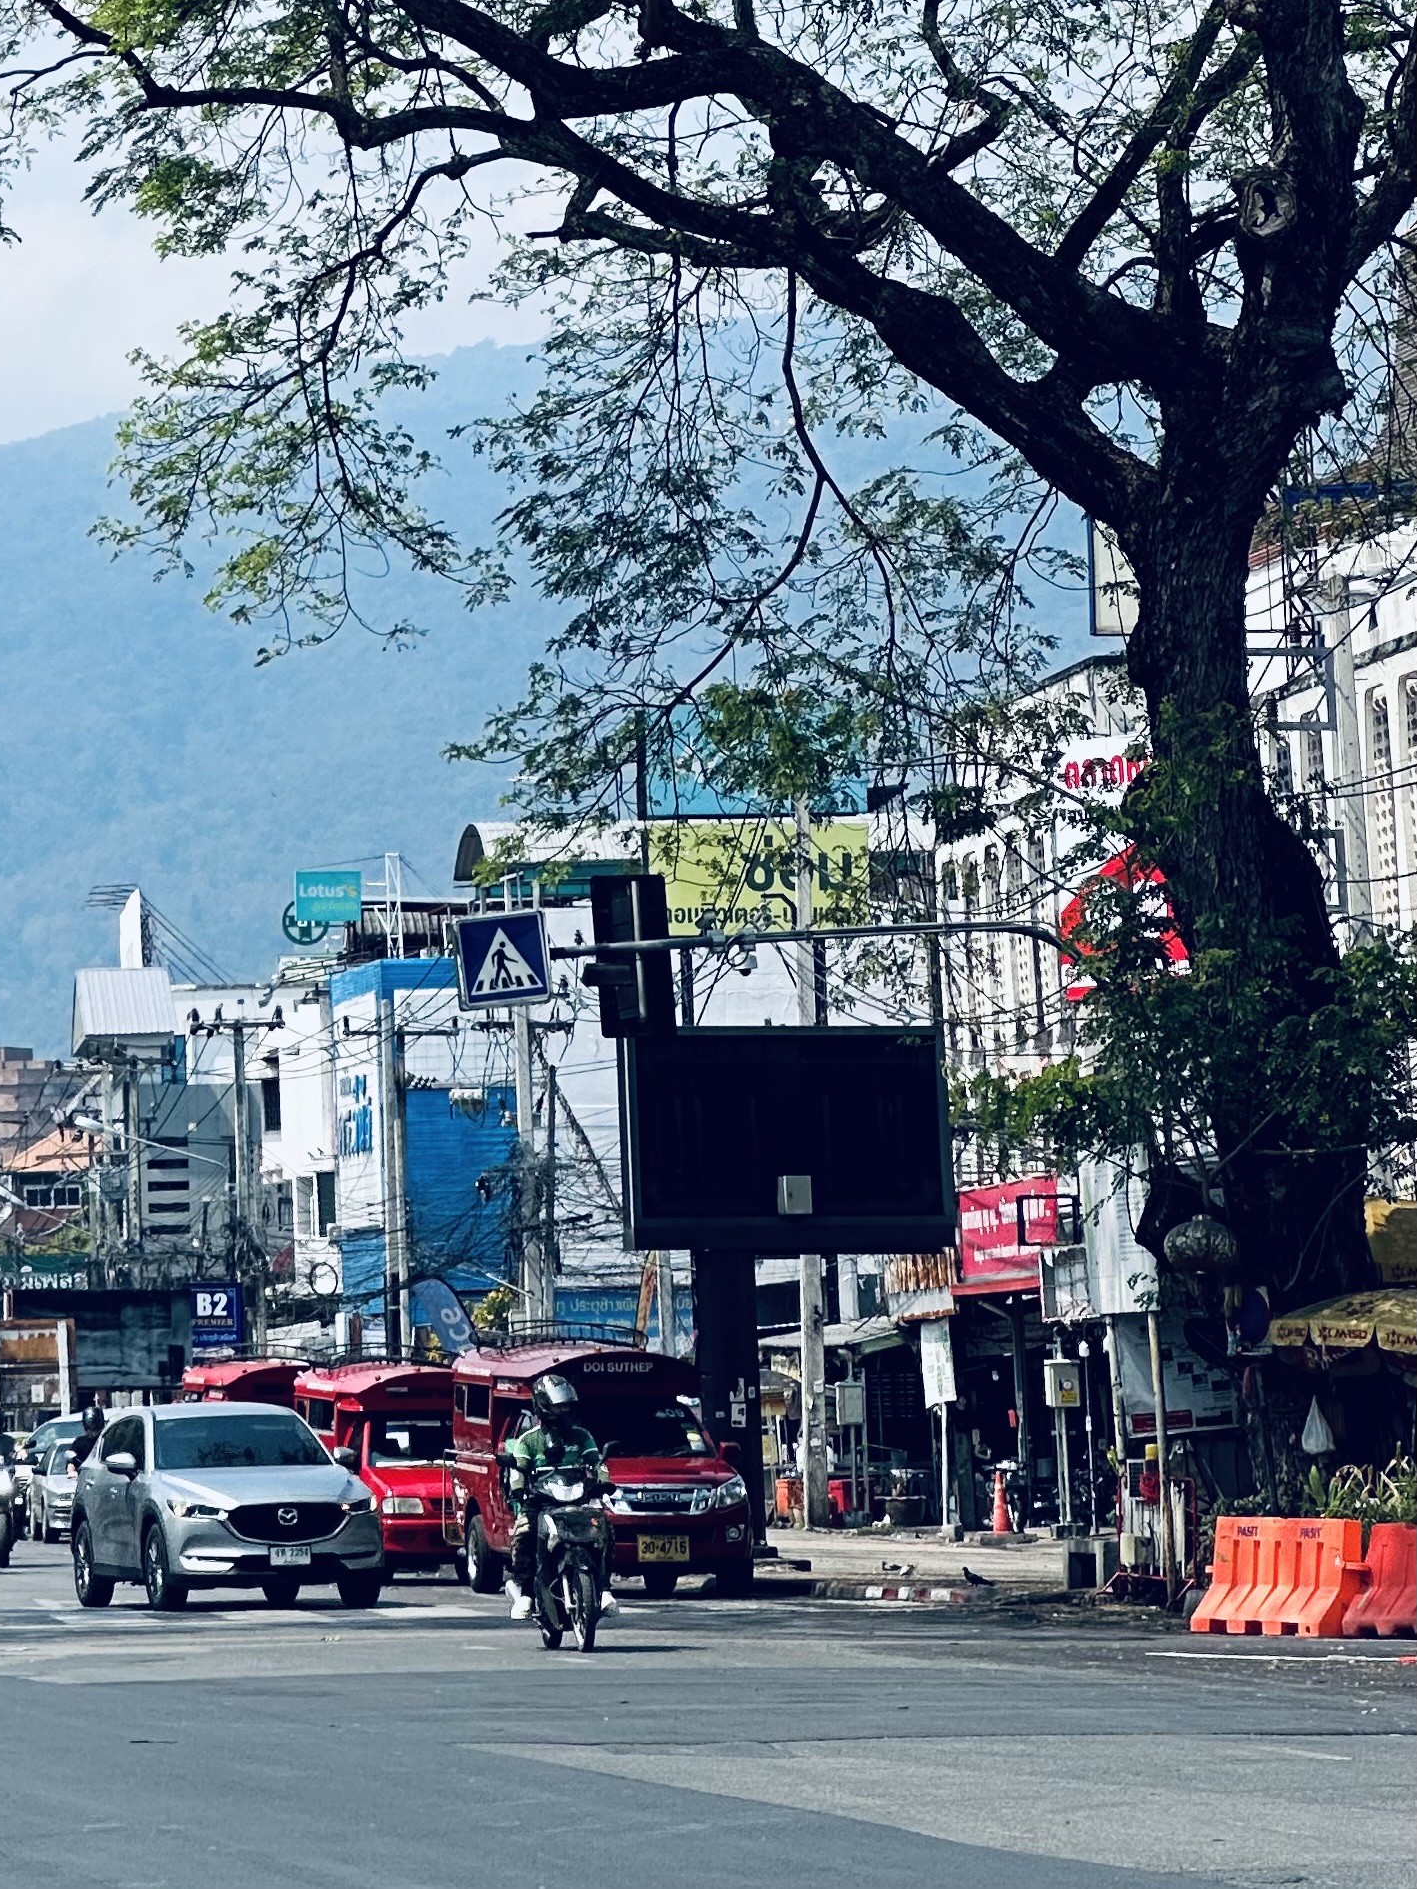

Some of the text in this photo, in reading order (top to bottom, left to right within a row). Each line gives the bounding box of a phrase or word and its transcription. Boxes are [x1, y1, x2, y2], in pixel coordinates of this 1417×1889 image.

[196, 1292, 228, 1317] B2
[584, 1362, 653, 1372] DOI SUTHEP
